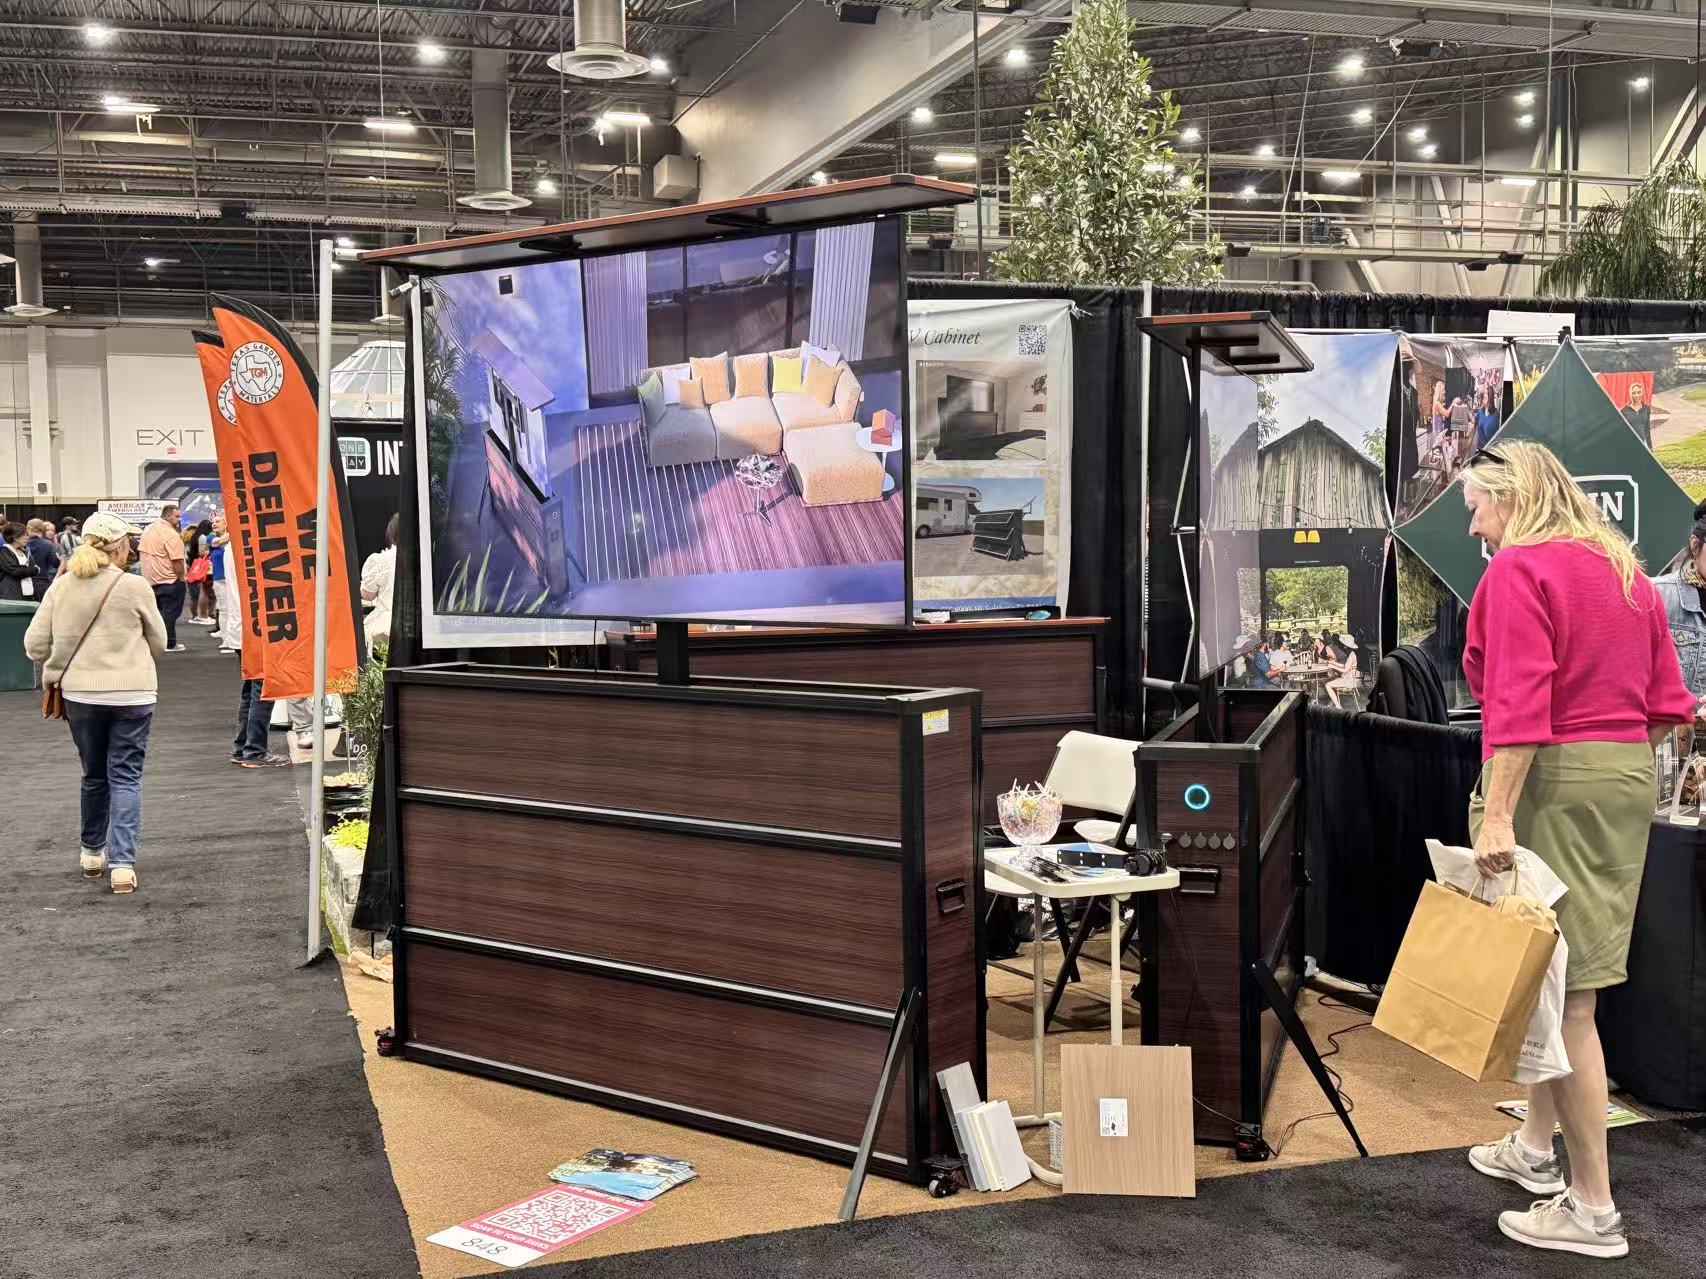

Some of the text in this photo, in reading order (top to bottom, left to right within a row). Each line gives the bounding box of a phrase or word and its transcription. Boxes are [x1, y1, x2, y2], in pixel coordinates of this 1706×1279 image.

[924, 328, 982, 345] Cabinet
[231, 343, 281, 372] TEXAS GARDEN
[248, 366, 268, 378] TGM
[238, 383, 280, 404] MATERIALS
[136, 428, 205, 446] EXIT
[348, 459, 365, 467] AY
[376, 440, 404, 476] IN
[248, 451, 299, 644] DELIVER
[296, 507, 332, 581] WE
[461, 1238, 508, 1255] 848
